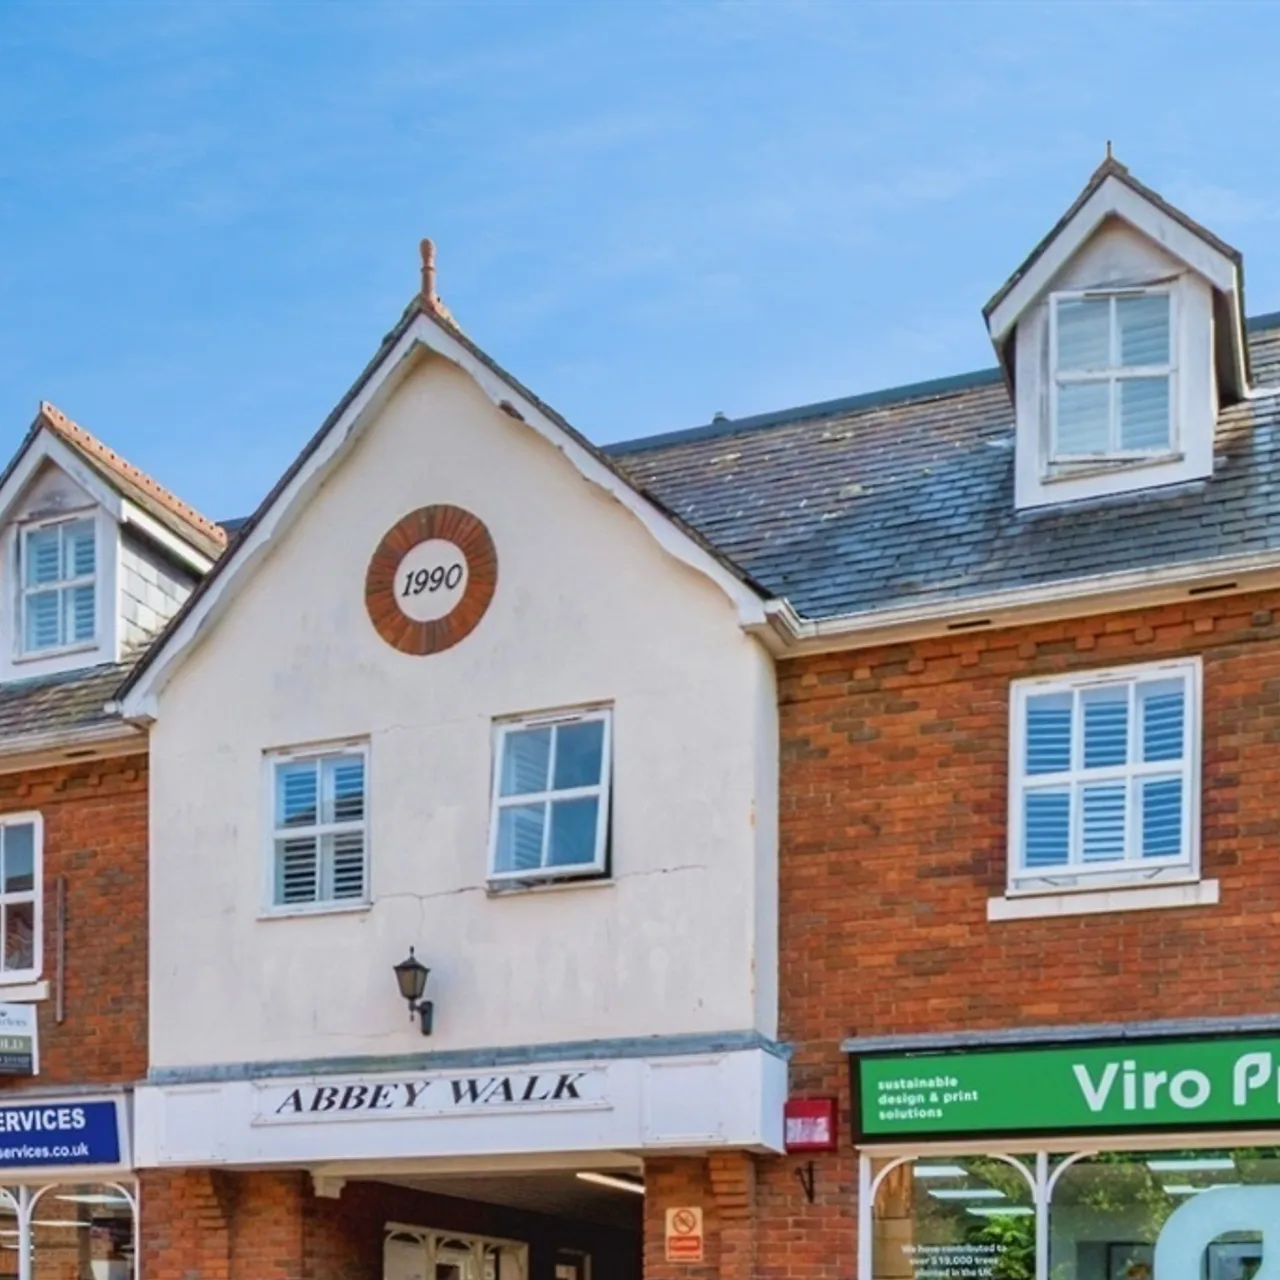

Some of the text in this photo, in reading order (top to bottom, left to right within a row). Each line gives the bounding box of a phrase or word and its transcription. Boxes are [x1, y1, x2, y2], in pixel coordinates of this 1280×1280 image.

[402, 563, 463, 598] 1990
[878, 1075, 958, 1090] sustainable
[1072, 1060, 1211, 1112] Viro
[276, 1072, 585, 1114] ABBEY WALK
[878, 1090, 978, 1106] design & print
[879, 1107, 943, 1120] solutions
[942, 1243, 995, 1253] contributed
[978, 1267, 994, 1277] UK
